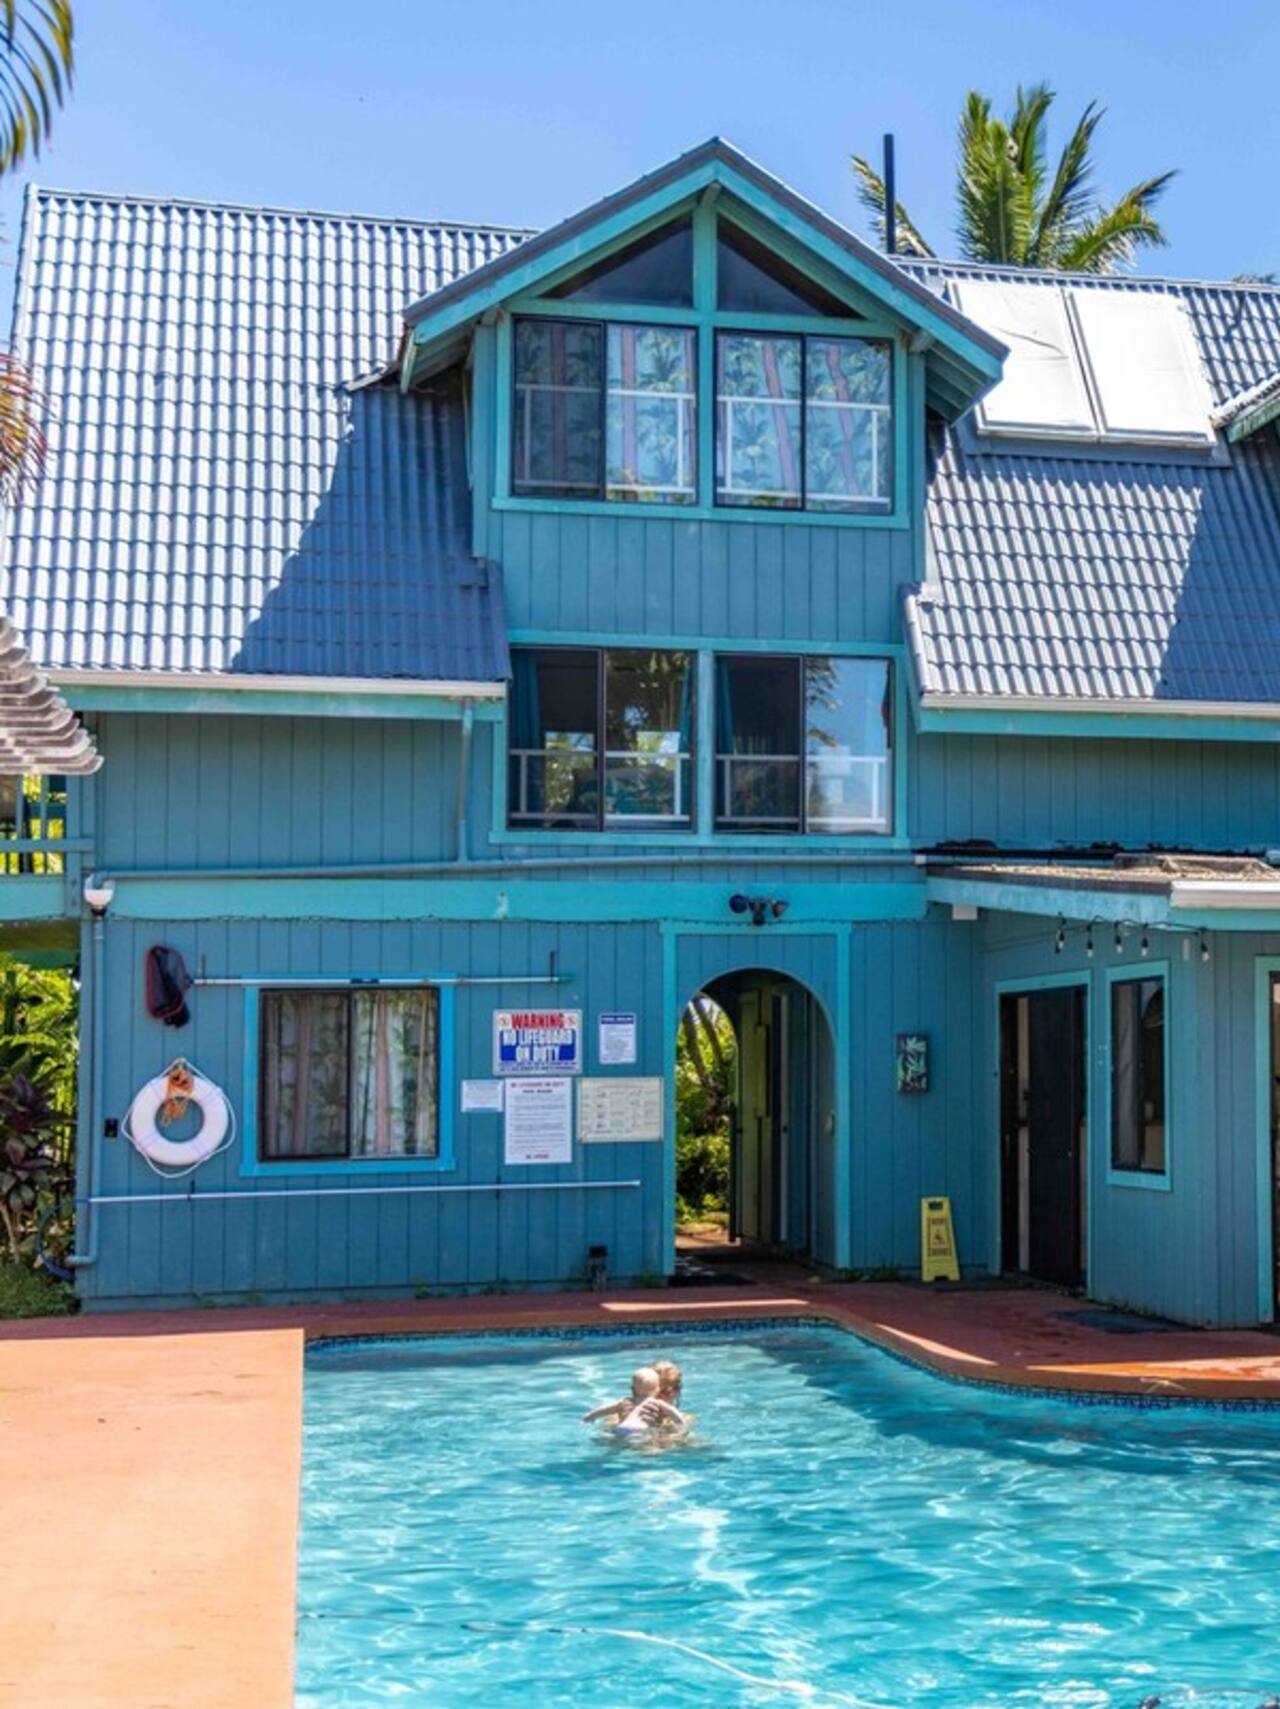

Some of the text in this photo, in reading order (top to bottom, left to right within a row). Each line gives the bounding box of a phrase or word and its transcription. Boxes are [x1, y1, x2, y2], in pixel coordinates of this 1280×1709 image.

[511, 1012, 564, 1029] WARNING
[502, 1029, 573, 1047] NO LIFEGUARD
[515, 1045, 560, 1062] ON DUTY
